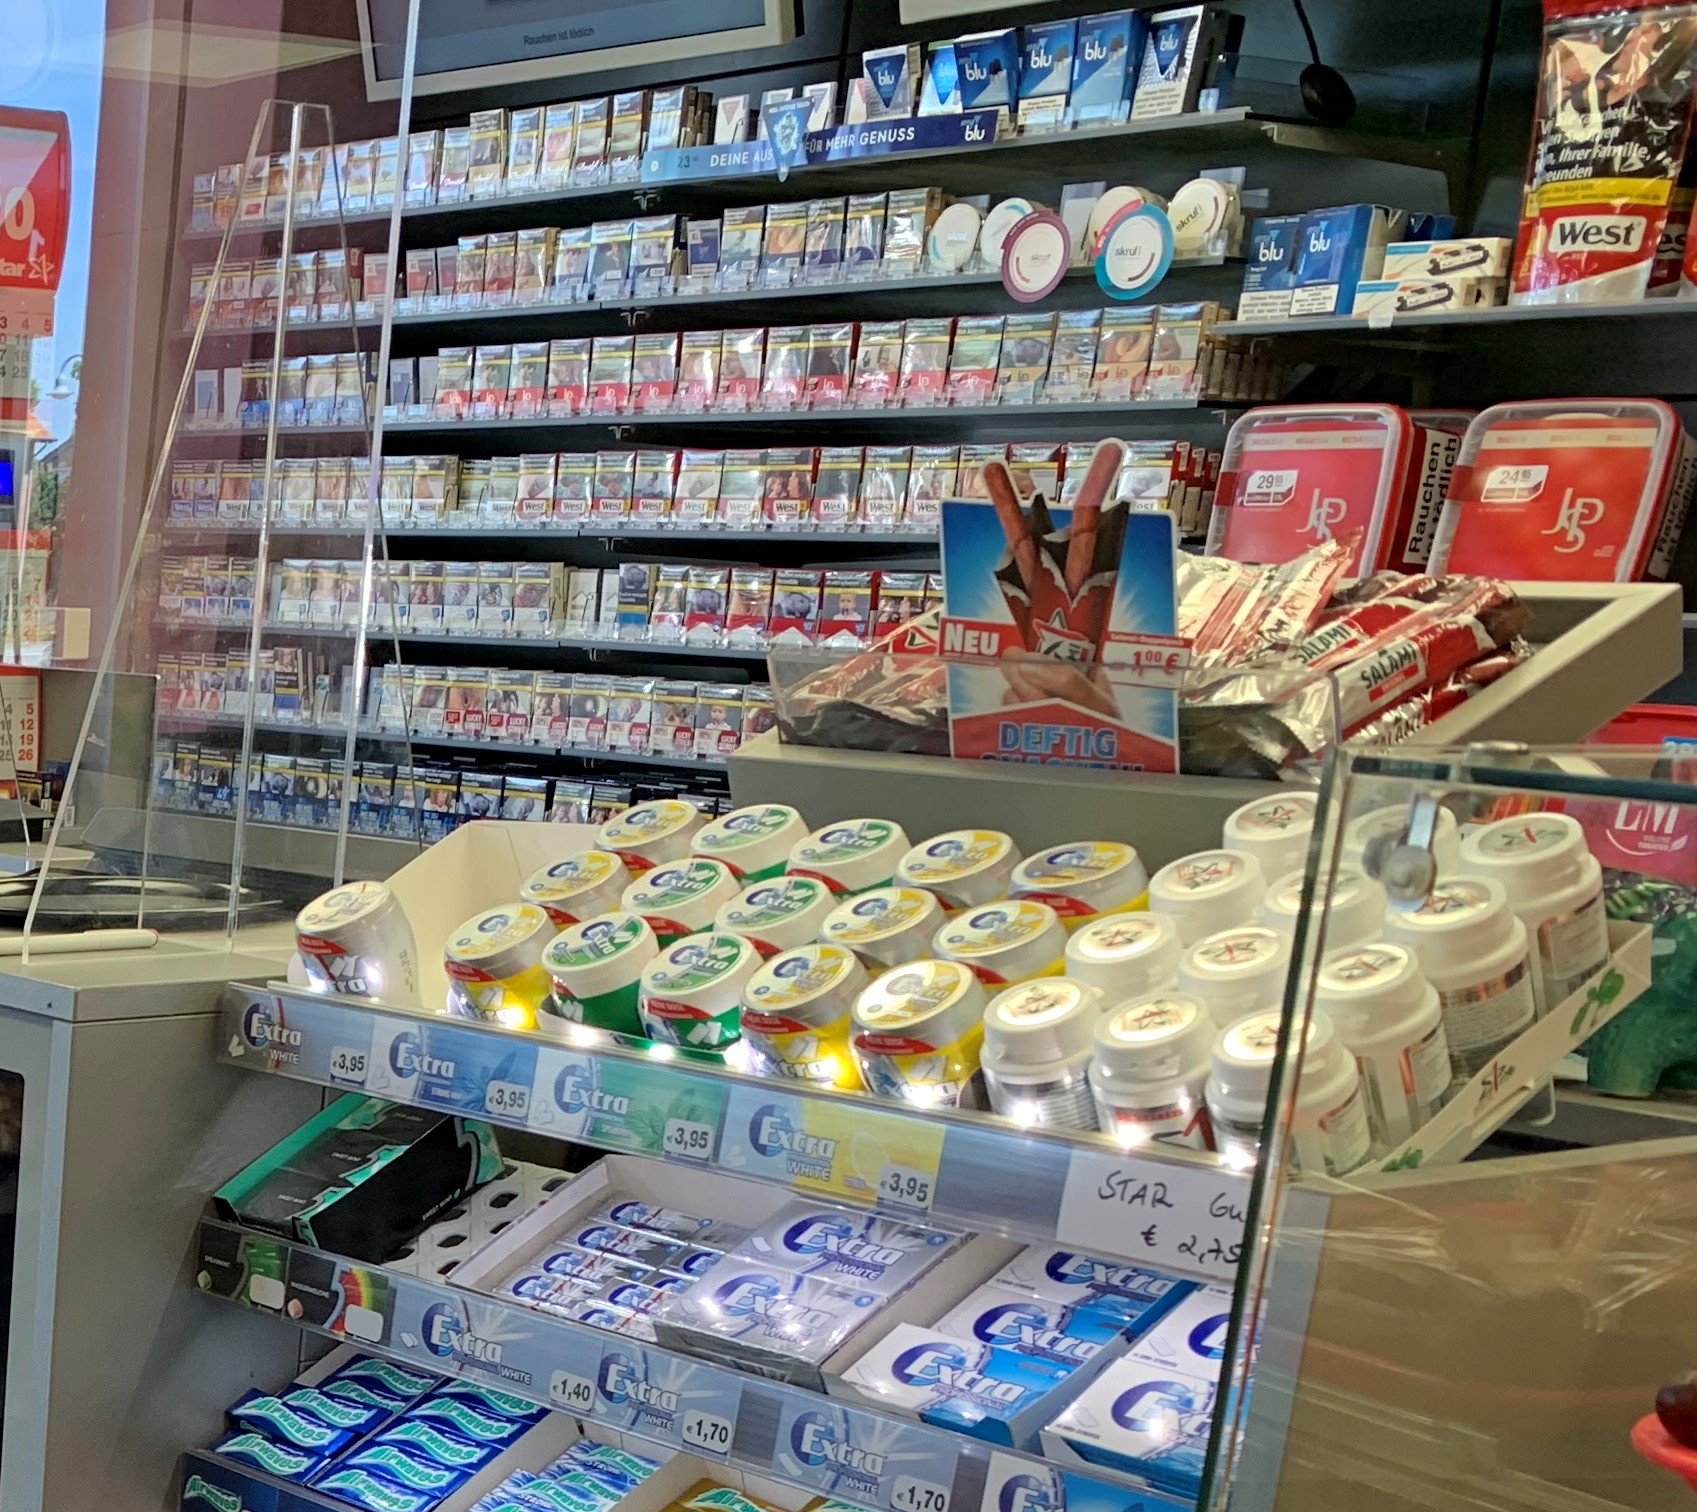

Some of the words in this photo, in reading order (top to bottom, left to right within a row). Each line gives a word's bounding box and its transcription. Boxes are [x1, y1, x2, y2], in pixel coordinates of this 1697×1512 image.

[523, 31, 556, 46] Rauchen
[1030, 48, 1053, 70] blu
[1084, 41, 1107, 61] blu
[965, 60, 987, 81] blu
[825, 135, 856, 151] MEHR
[859, 127, 916, 147] GENUSS
[964, 118, 986, 142] blu
[709, 150, 749, 168] DEINE
[1558, 147, 1593, 163] Ihrer
[1308, 232, 1331, 253] blu
[1559, 220, 1638, 246] West
[1258, 241, 1284, 263] blu
[522, 500, 546, 512] West
[775, 501, 798, 512] West
[1408, 441, 1442, 554] Rauchen
[944, 621, 1001, 657] NEU
[1360, 642, 1419, 690] SALAMI
[998, 720, 1118, 759] DEFTIG
[249, 1008, 302, 1046] Extra
[269, 1048, 300, 1065] WHITE
[562, 1071, 630, 1115] Extra
[755, 1113, 838, 1161] Extra
[785, 1158, 831, 1183] WHITE
[1097, 1171, 1174, 1210] STAR
[799, 1221, 908, 1270] Extra
[1140, 1225, 1158, 1248] €
[834, 1261, 881, 1281] WHITE
[430, 1313, 503, 1366] Extra
[914, 1349, 1029, 1402] Extra
[643, 1412, 675, 1432] WHITE
[801, 1421, 887, 1475] Extra
